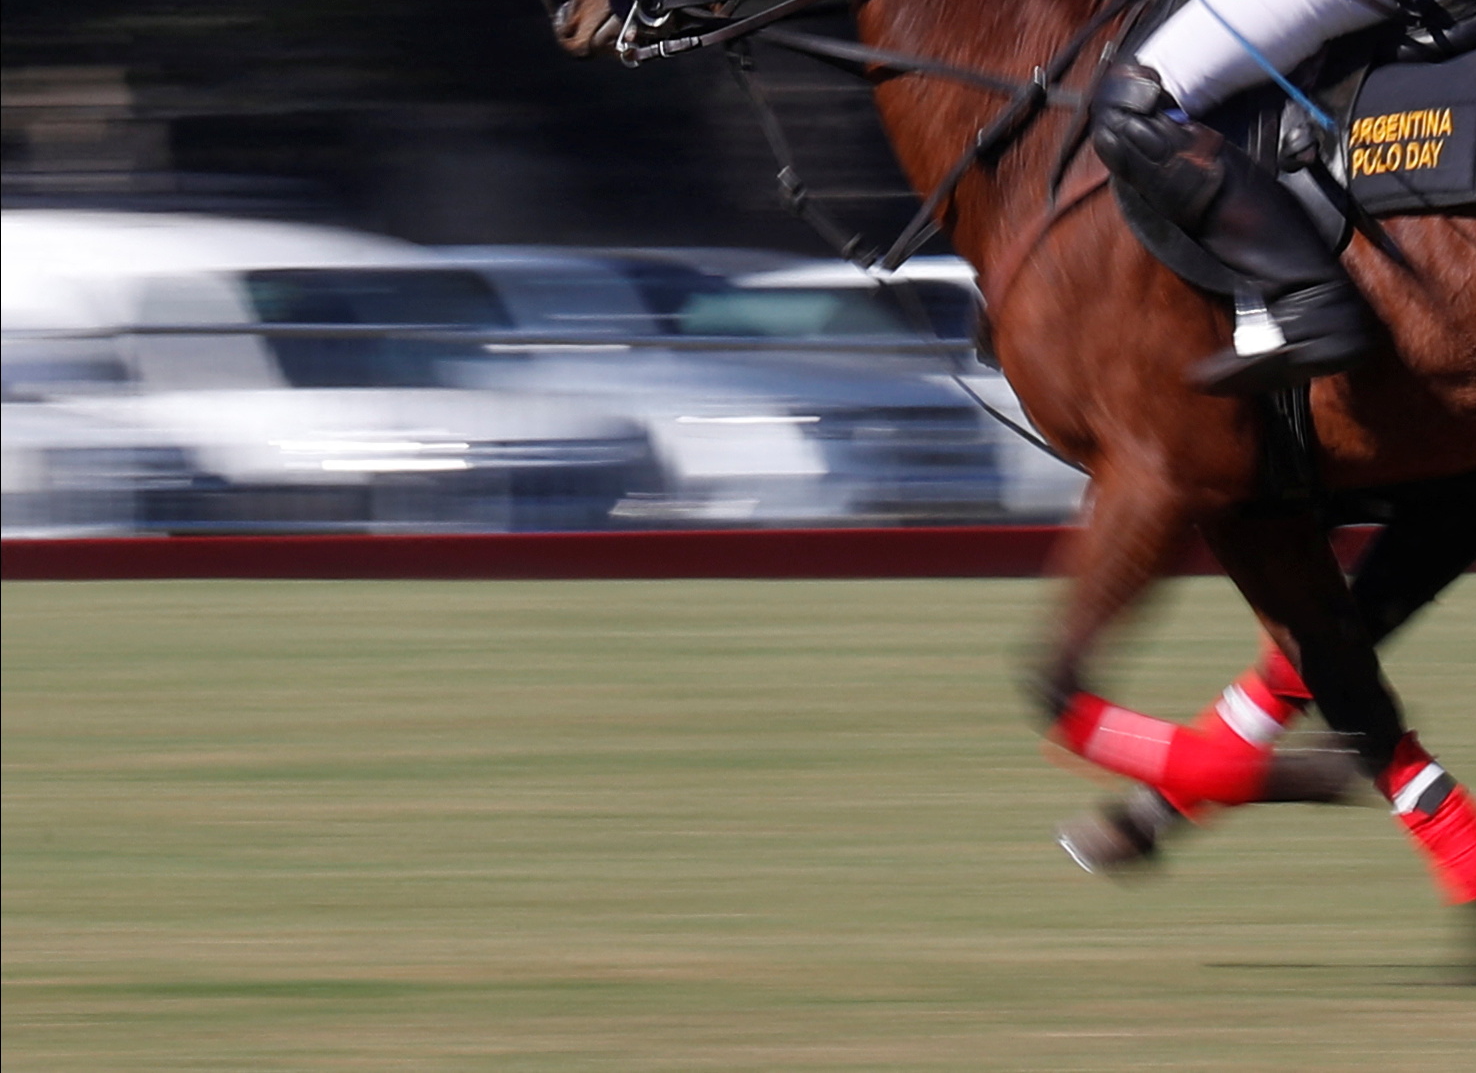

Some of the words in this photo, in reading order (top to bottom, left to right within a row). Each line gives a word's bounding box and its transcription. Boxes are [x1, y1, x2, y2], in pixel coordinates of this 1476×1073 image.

[1348, 107, 1452, 149] ARGENTINA
[1351, 143, 1402, 180] POLO
[1405, 138, 1444, 171] DAY
